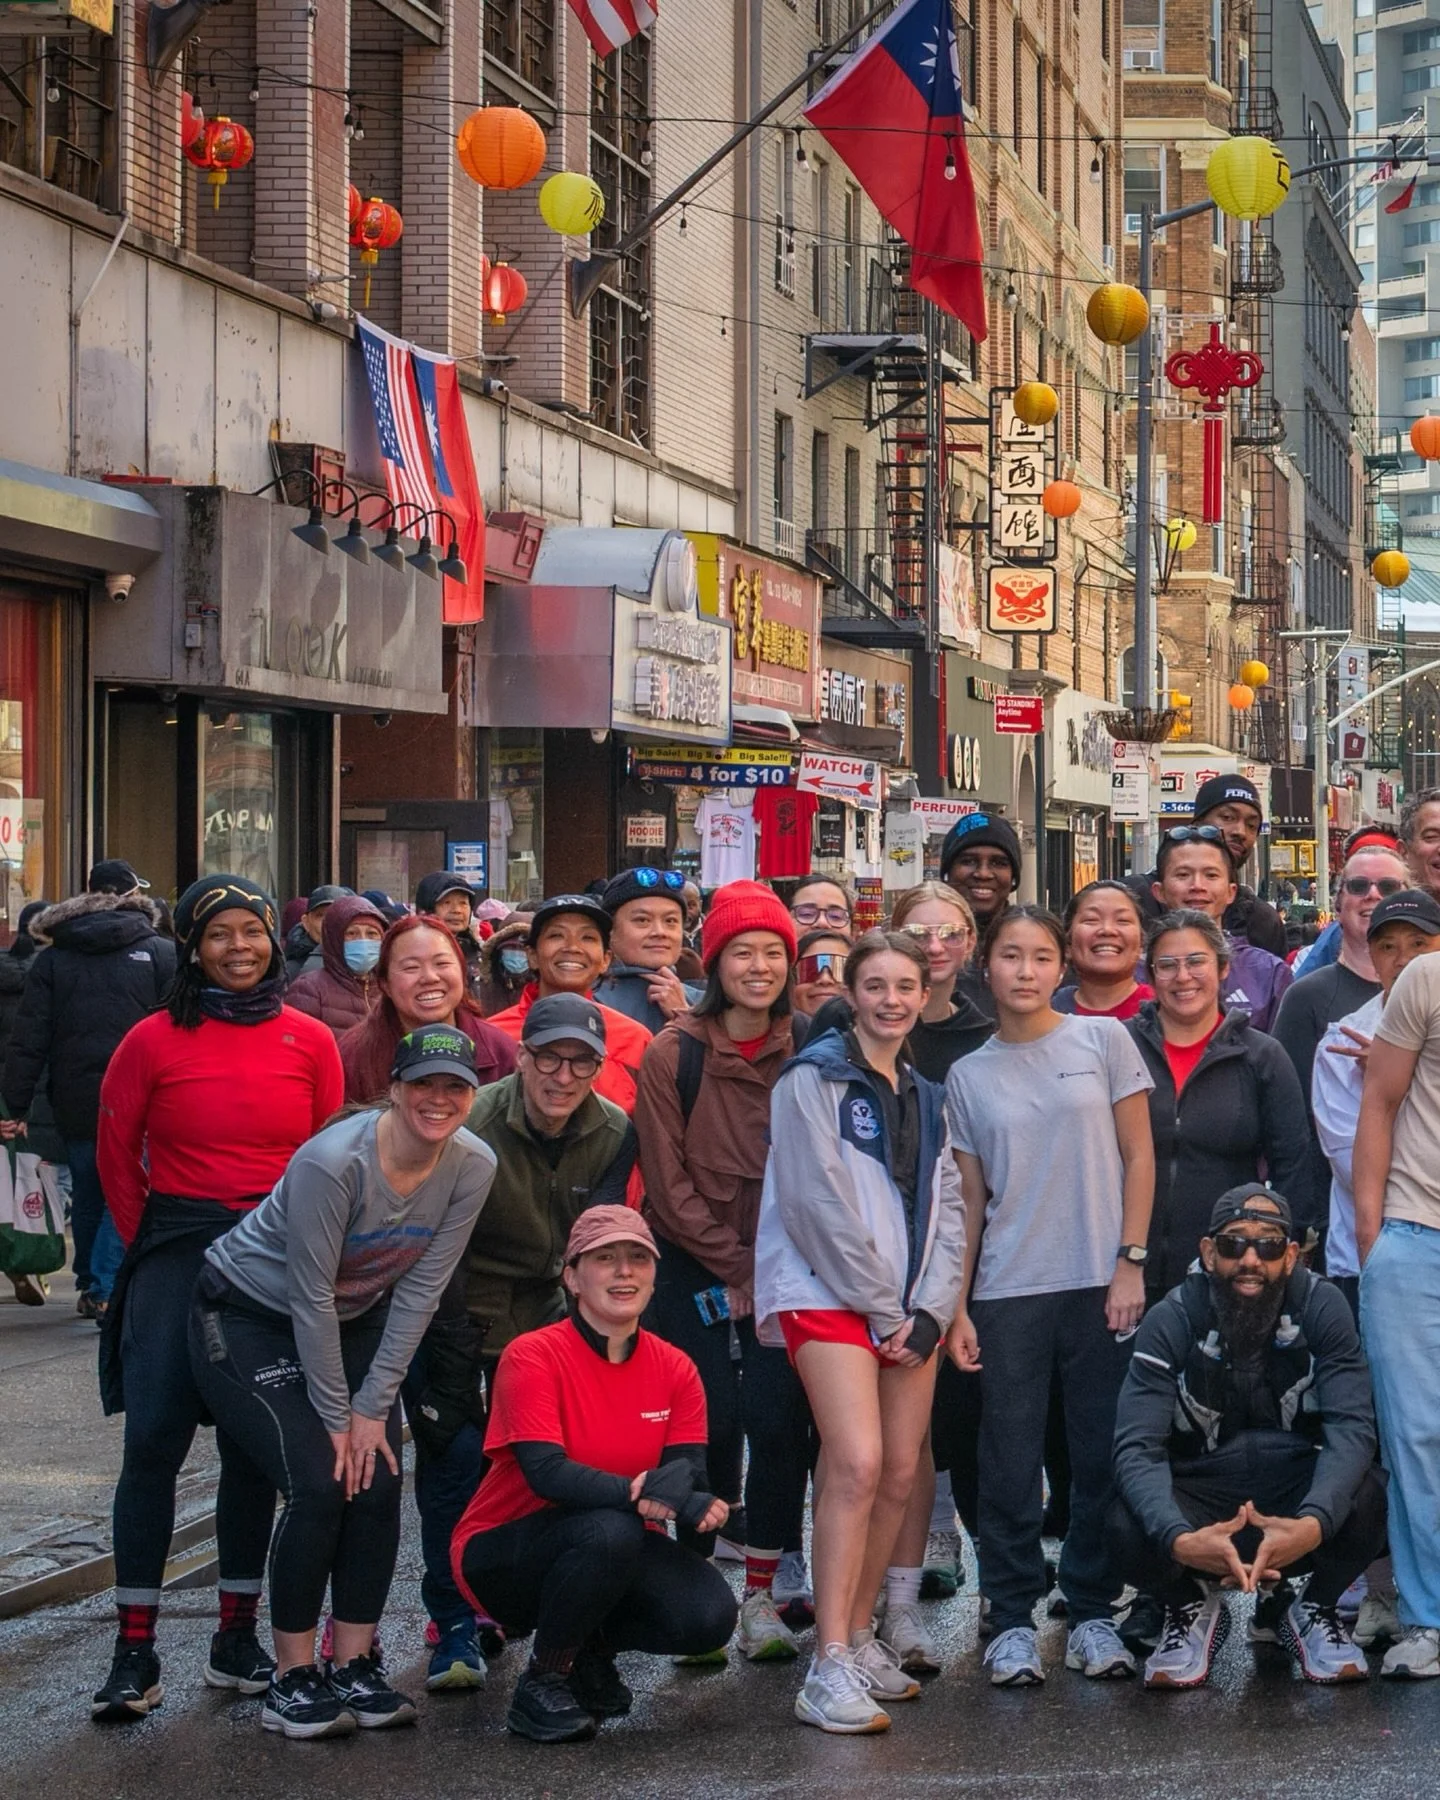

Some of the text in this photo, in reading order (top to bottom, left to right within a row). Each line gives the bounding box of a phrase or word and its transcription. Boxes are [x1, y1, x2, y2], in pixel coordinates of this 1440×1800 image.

[997, 699, 1036, 708] NO STANDING
[998, 708, 1021, 717] Anytime
[687, 751, 703, 760] Big
[739, 752, 756, 764] Big
[758, 753, 789, 763] Sale!!!
[804, 756, 863, 777] WATCH
[690, 766, 704, 781] 4
[709, 766, 739, 783] for
[745, 767, 785, 784] $10
[1114, 773, 1123, 788] 2
[912, 801, 978, 816] PERFUME
[629, 827, 664, 837] HOODIE
[255, 1367, 296, 1381] BROOKLYN
